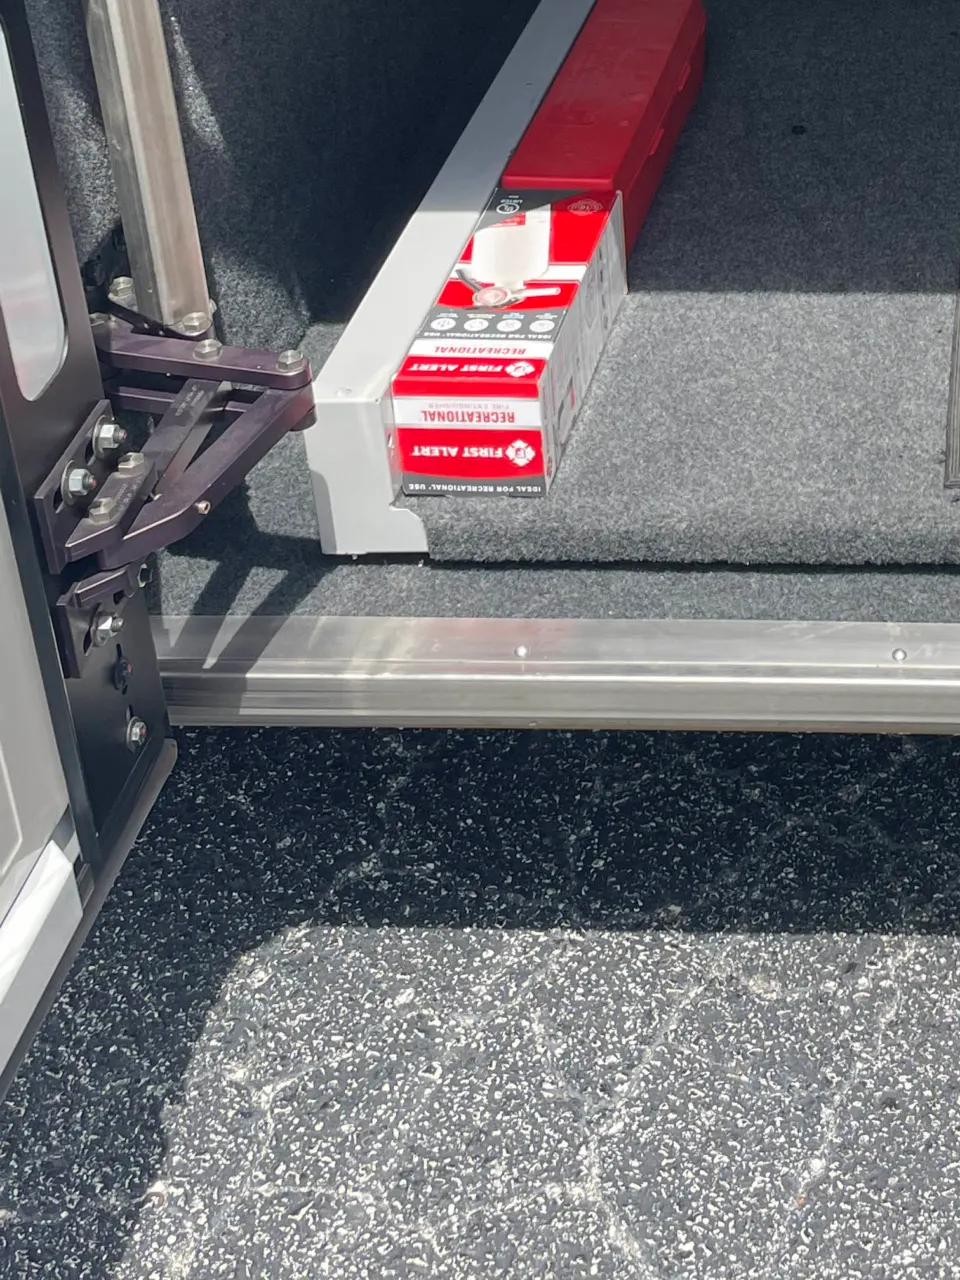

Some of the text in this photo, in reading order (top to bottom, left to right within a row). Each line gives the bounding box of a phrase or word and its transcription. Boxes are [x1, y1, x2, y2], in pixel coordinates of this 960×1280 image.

[434, 346, 527, 355] RECREATIONAL
[410, 363, 504, 372] FIRST ALERT
[421, 410, 515, 424] RECREATIONAL
[411, 445, 504, 458] FIRST ALERT
